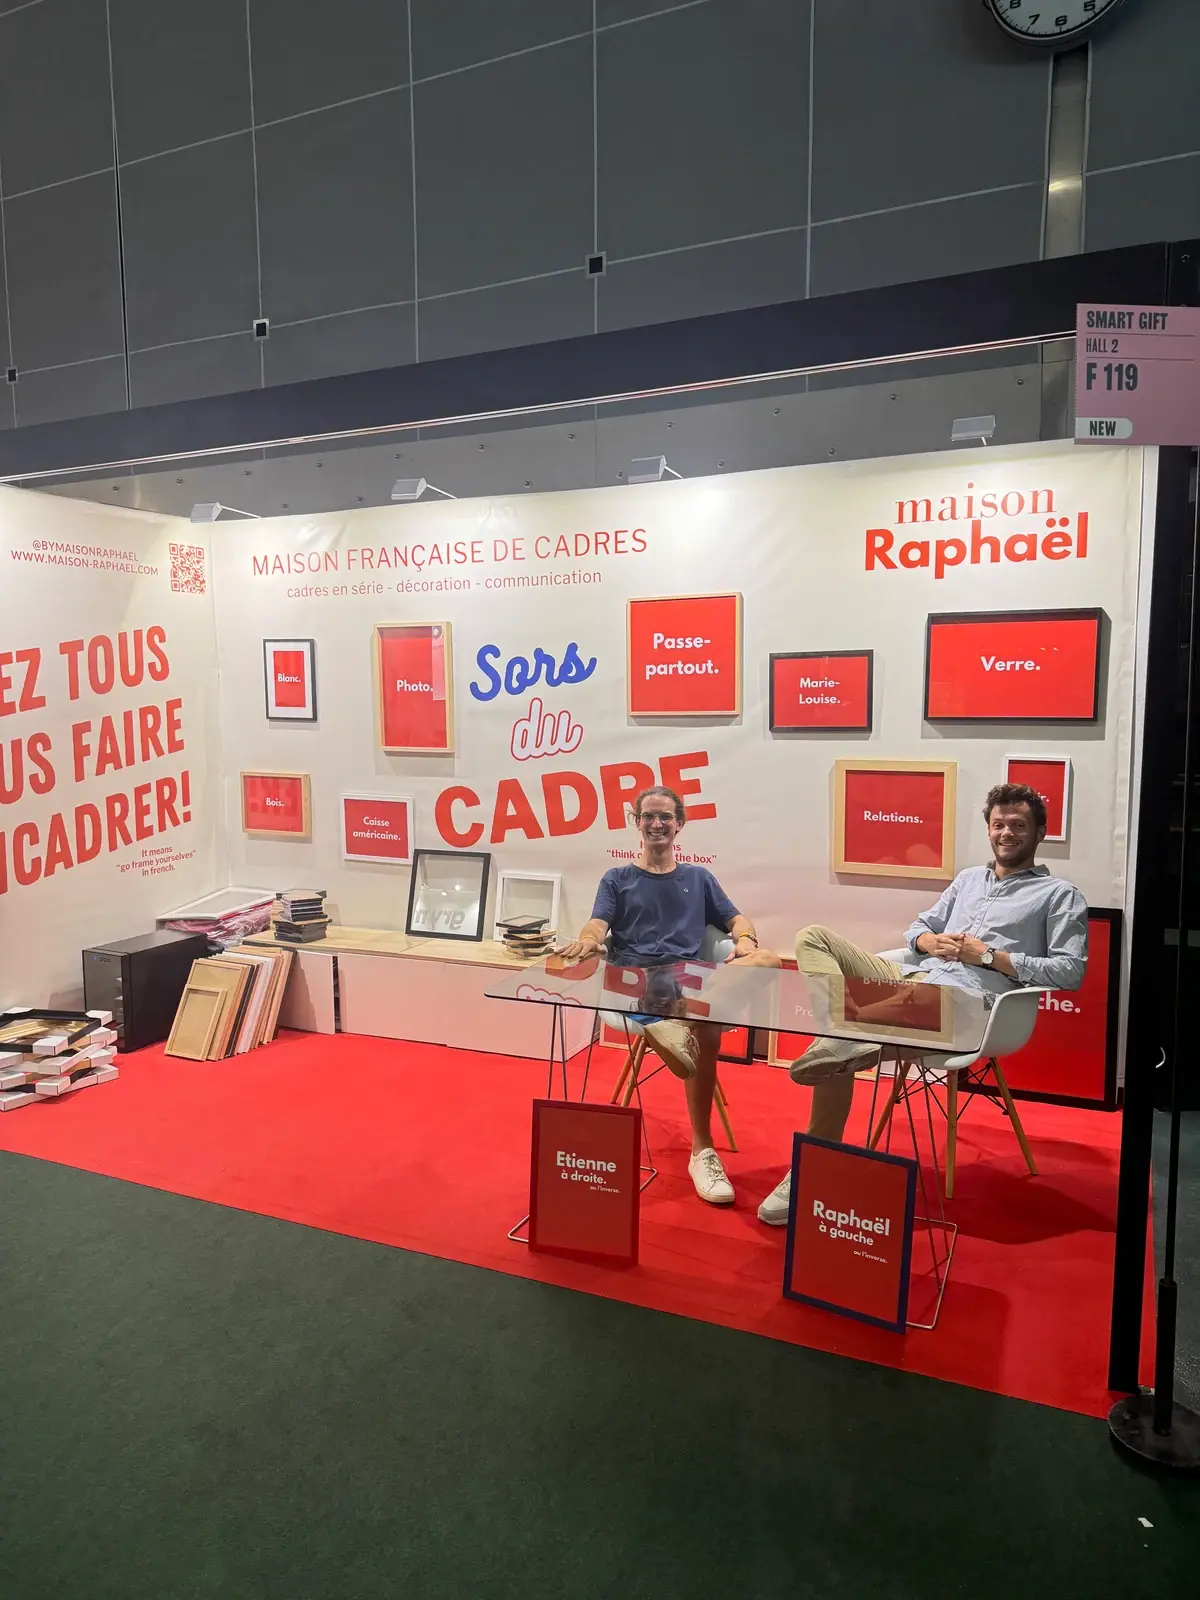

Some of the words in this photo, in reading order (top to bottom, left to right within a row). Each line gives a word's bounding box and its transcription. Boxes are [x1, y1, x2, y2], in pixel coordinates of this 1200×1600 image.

[1009, 0, 1021, 9] 8
[1083, 0, 1096, 12] 5
[1028, 14, 1041, 26] 7
[1054, 15, 1068, 26] 6
[1086, 310, 1134, 329] SMART
[1138, 312, 1168, 330] GIFT
[1086, 338, 1108, 353] HALL
[1111, 339, 1119, 353] 2
[1086, 362, 1097, 391] F
[1103, 363, 1139, 391] 119
[1089, 420, 1116, 436] NEW
[894, 482, 1057, 525] maison
[32, 540, 138, 561] @BYMAISONRAPHAEL
[252, 550, 339, 576] MAISON
[347, 540, 484, 572] FRANÇAISE
[493, 537, 526, 562] DE
[534, 528, 647, 559] CADRES
[864, 511, 1089, 580] Raphaël
[11, 549, 158, 576] WWW.MAISON-RAPHAEL.COM
[287, 583, 329, 598] cadres
[332, 584, 348, 596] en
[351, 581, 384, 594] série
[396, 576, 471, 593] décoration
[484, 569, 602, 589] communication
[652, 632, 712, 650] Passe-
[59, 625, 170, 701] TOUS
[645, 659, 720, 681] partout.
[980, 655, 1041, 672] Verre.
[277, 673, 301, 683] Blanc.
[469, 642, 598, 702] Sors
[396, 679, 434, 693] Photo.
[799, 677, 840, 689] Marie-
[798, 693, 841, 705] Louise.
[510, 696, 584, 762] du
[72, 697, 185, 783] FAIRE
[265, 797, 285, 807] Bois.
[434, 750, 717, 848] CADRE
[362, 816, 390, 827] Caisse
[863, 810, 924, 824] Relations.
[352, 829, 401, 841] américaine.
[141, 849, 148, 857] It
[149, 846, 173, 857] means
[675, 853, 691, 862] the
[132, 859, 154, 869] frame
[142, 868, 149, 876] in
[150, 863, 175, 875] french.
[556, 1150, 617, 1173] Etienne
[561, 1169, 568, 1180] à
[570, 1170, 607, 1185] droite.
[813, 1199, 890, 1236] Raphaël
[818, 1220, 827, 1233] à
[829, 1226, 874, 1246] gauche
